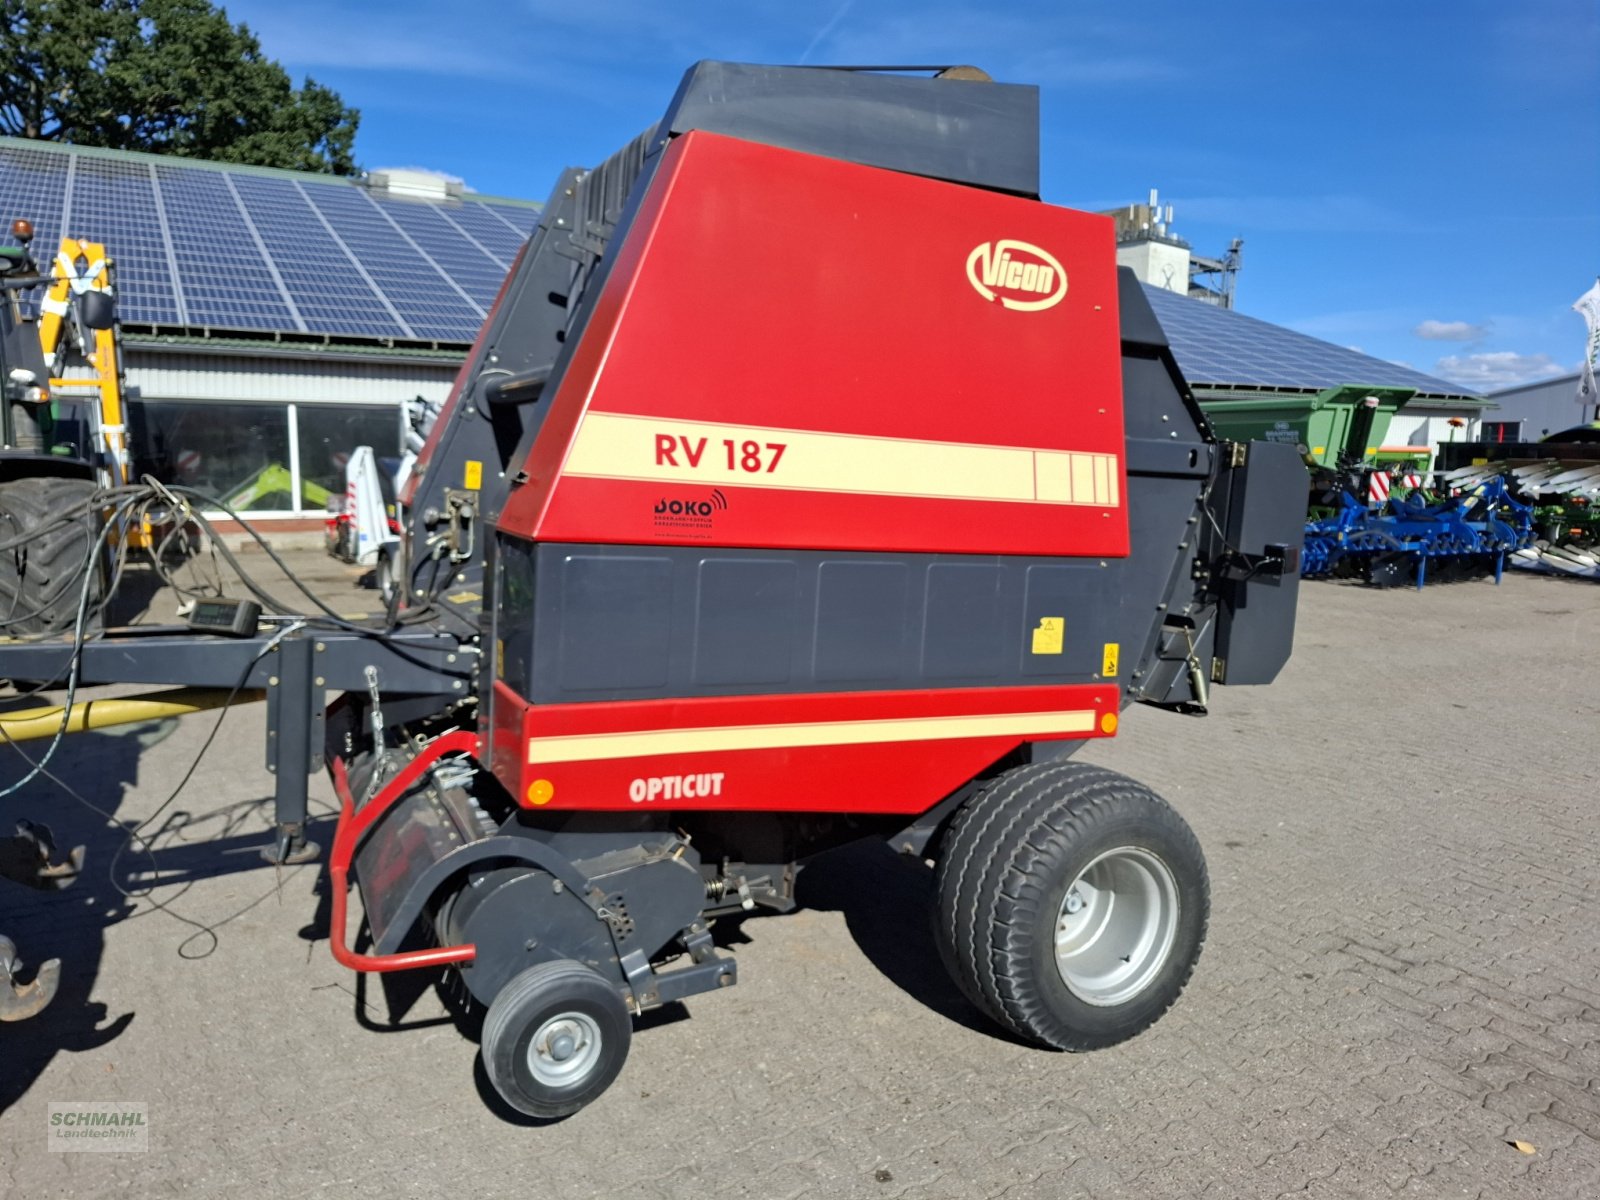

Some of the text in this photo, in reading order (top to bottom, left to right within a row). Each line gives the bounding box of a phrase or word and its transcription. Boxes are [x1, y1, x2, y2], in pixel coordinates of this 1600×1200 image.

[979, 240, 1056, 296] Vicon
[655, 434, 787, 473] RV 187
[654, 498, 712, 516] JOKO
[629, 772, 725, 803] OPTICUT
